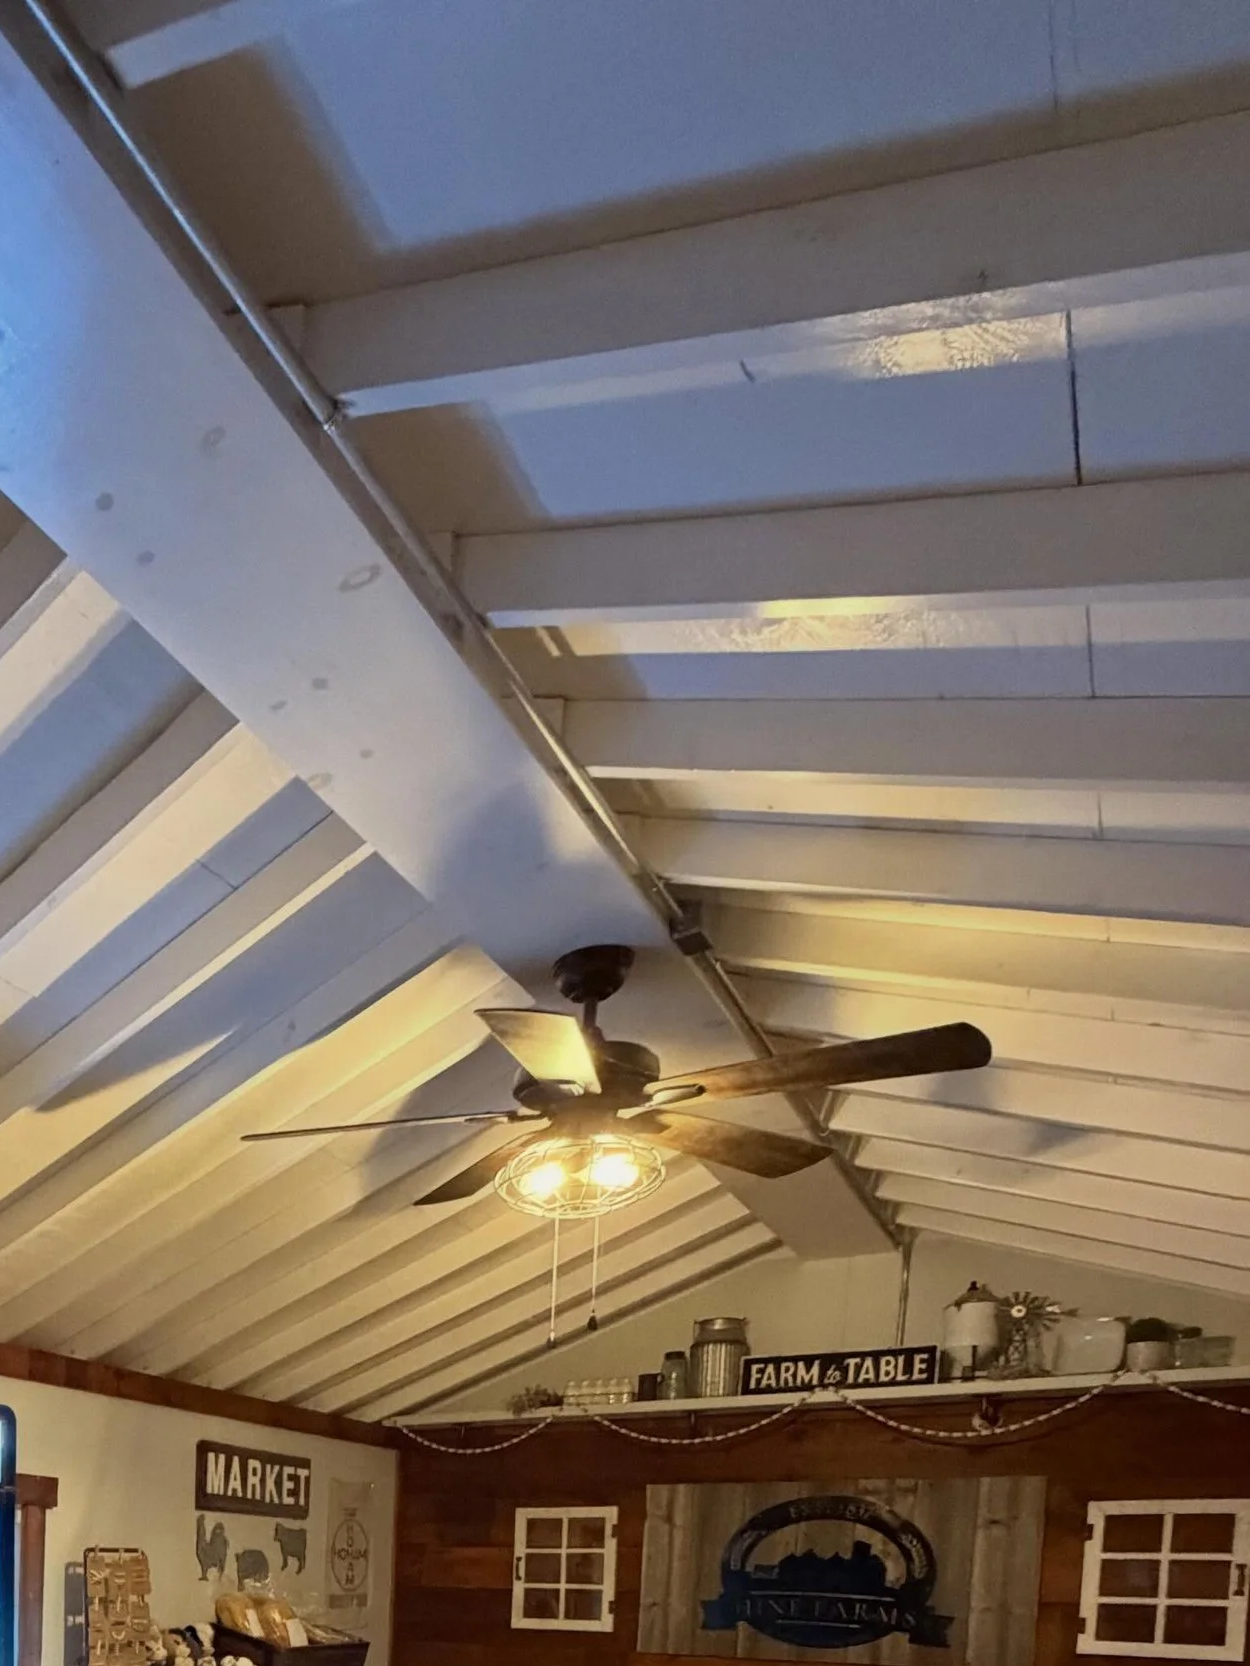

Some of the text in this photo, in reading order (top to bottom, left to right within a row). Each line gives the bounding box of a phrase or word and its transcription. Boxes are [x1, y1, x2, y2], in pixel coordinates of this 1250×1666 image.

[750, 1353, 928, 1390] FARM to TABLE
[206, 1452, 310, 1506] MARKET
